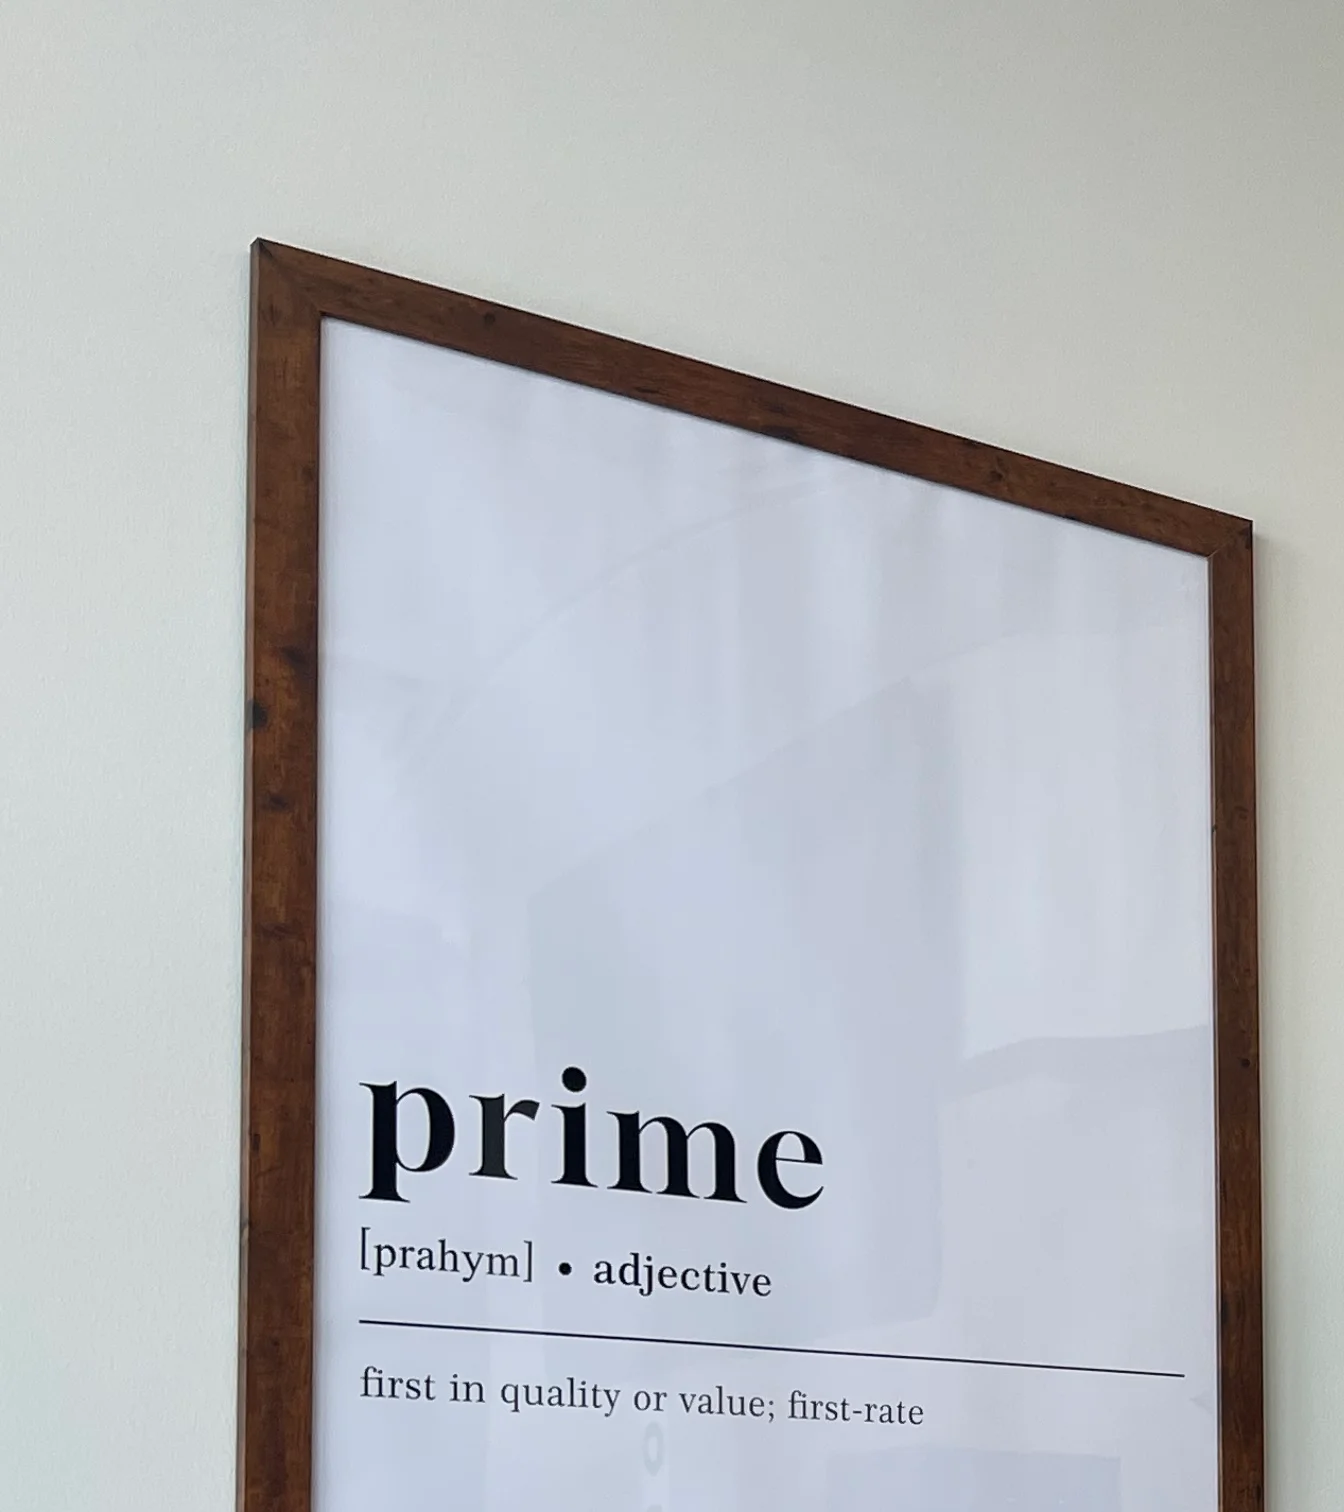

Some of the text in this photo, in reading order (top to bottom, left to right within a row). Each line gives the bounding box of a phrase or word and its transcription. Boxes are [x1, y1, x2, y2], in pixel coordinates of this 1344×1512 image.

[359, 1066, 824, 1209] prime
[360, 1227, 771, 1297] [prahym] adjective
[360, 1366, 925, 1425] first in quality or value; first-rate
